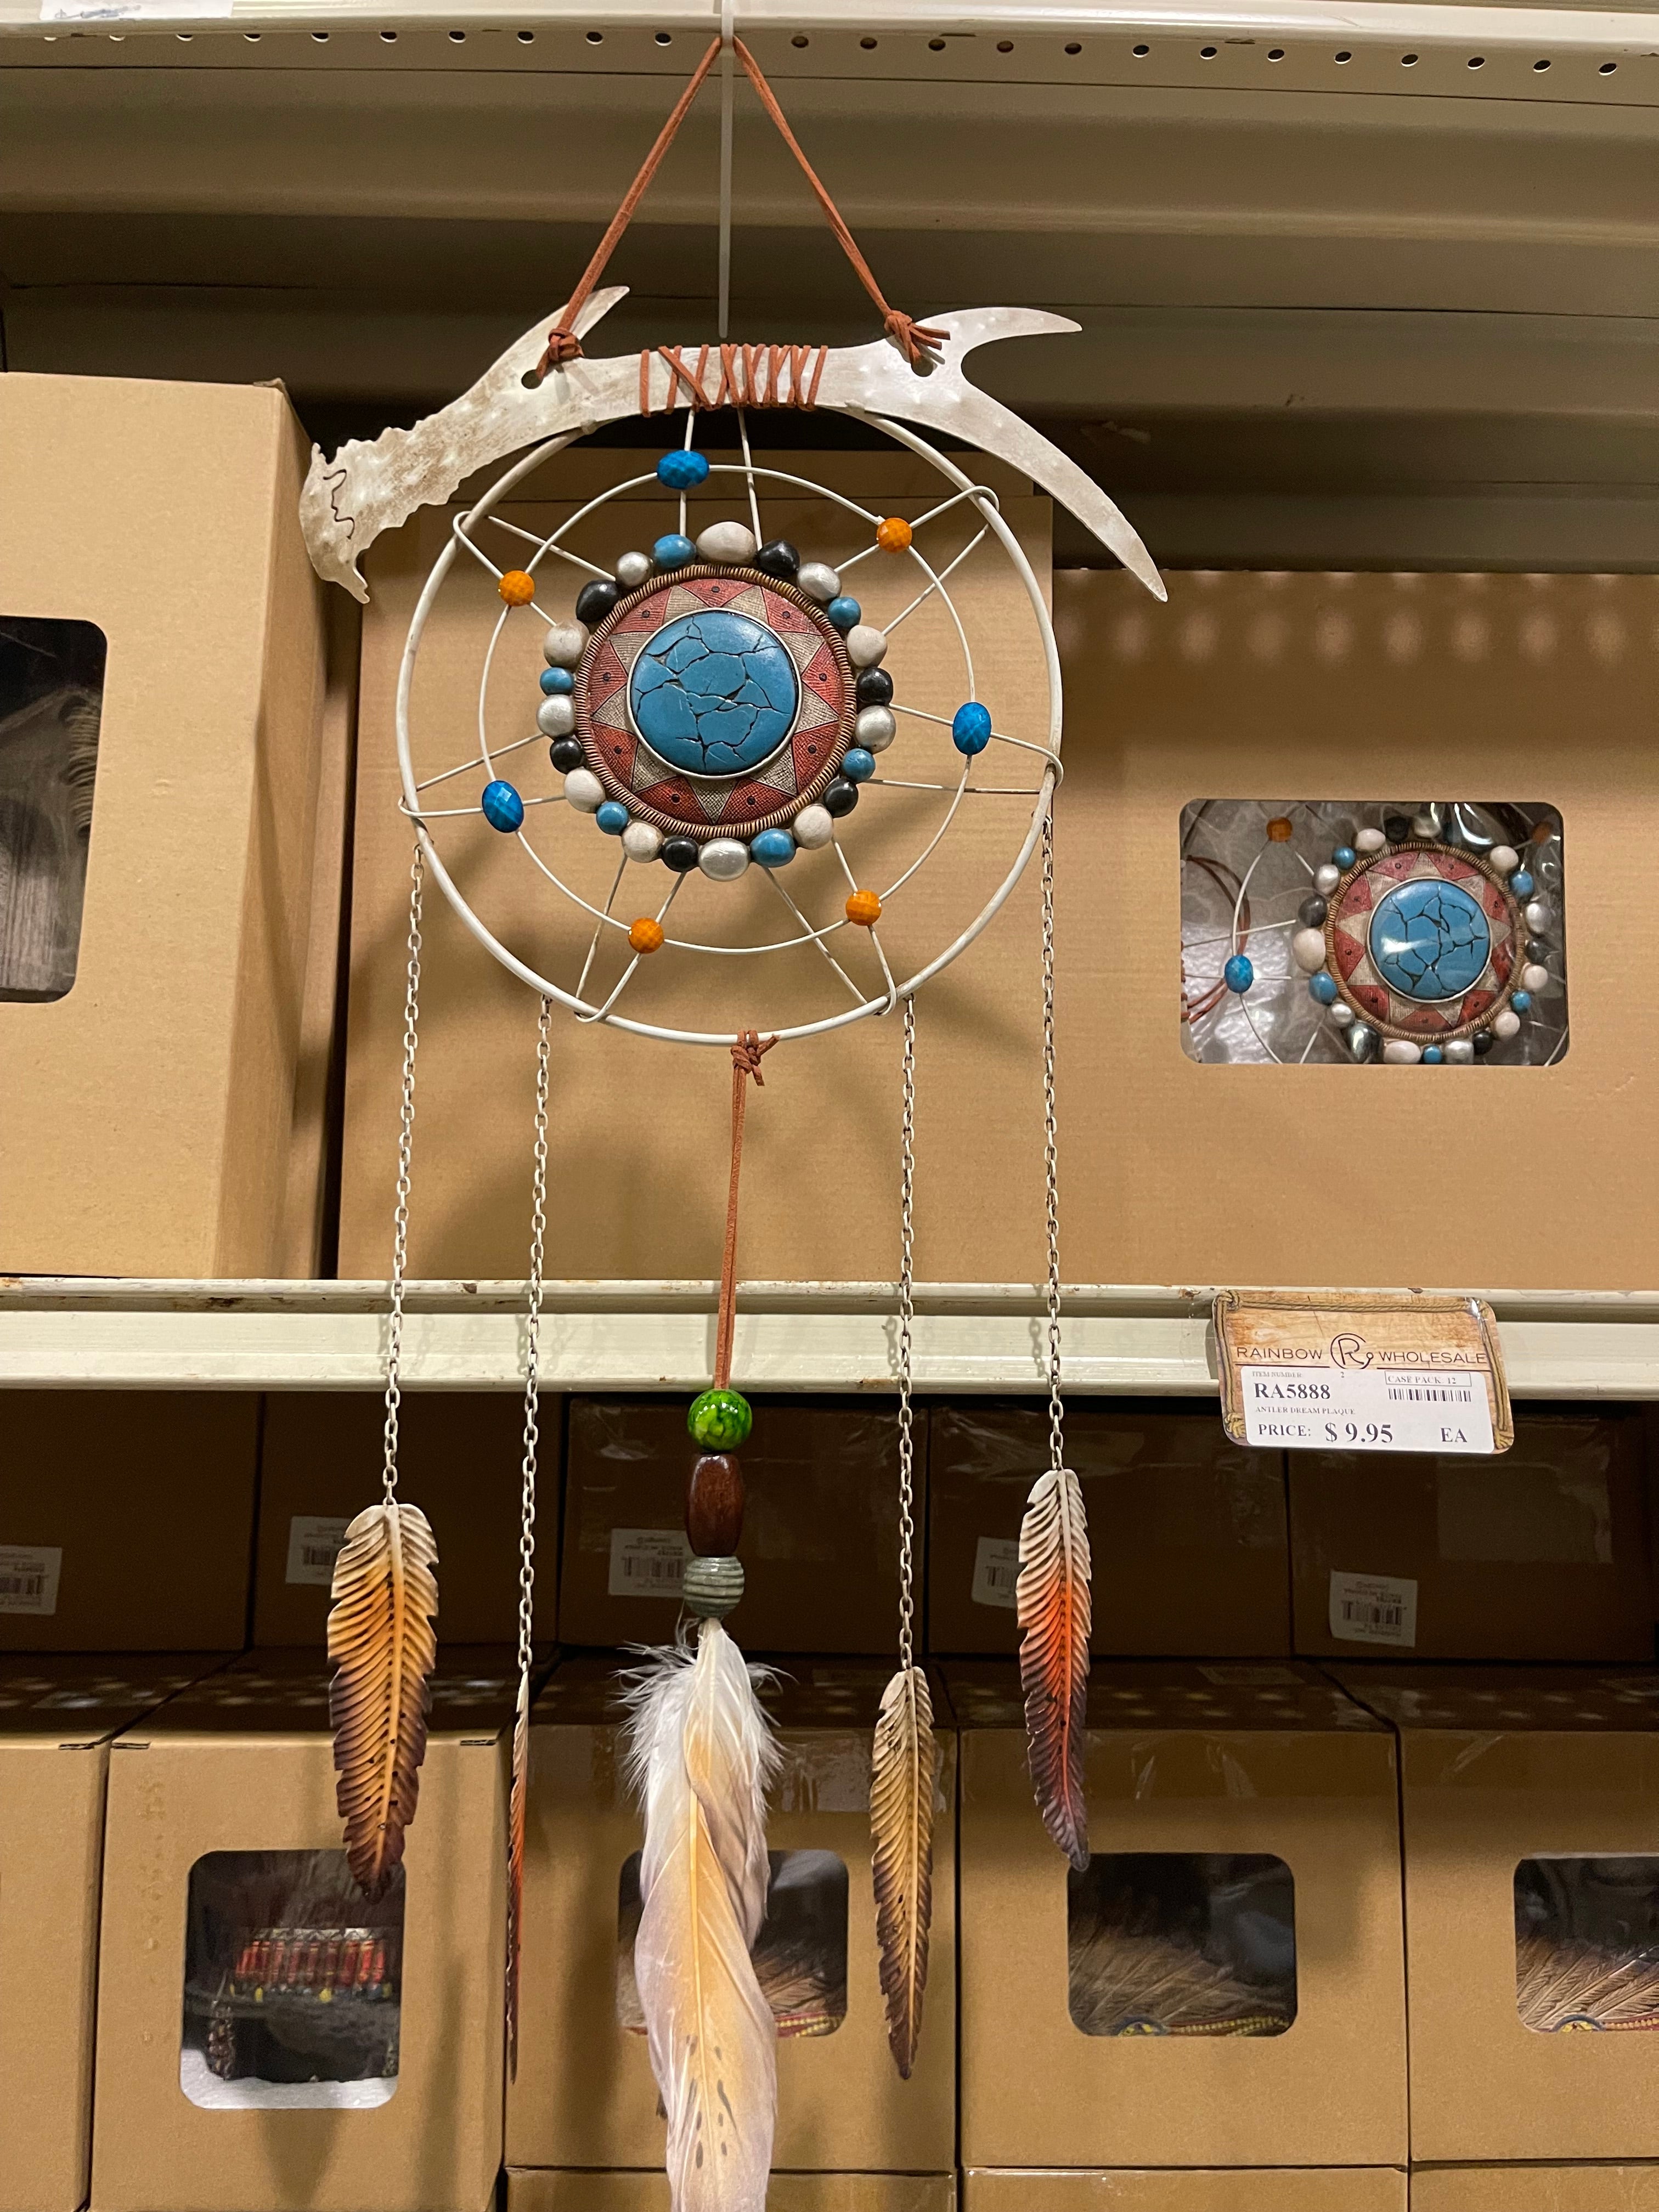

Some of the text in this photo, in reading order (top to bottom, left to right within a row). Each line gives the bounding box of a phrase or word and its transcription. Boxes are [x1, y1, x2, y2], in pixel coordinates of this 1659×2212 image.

[1237, 1347, 1322, 1359] RAINBOW
[1378, 1351, 1488, 1364] WHOLESALE
[1387, 1375, 1412, 1384] CASE
[1254, 1383, 1331, 1400] RA5888
[1259, 1424, 1311, 1437] PRICE:
[1324, 1422, 1393, 1443] $ 9.95
[1440, 1427, 1468, 1443] EA
